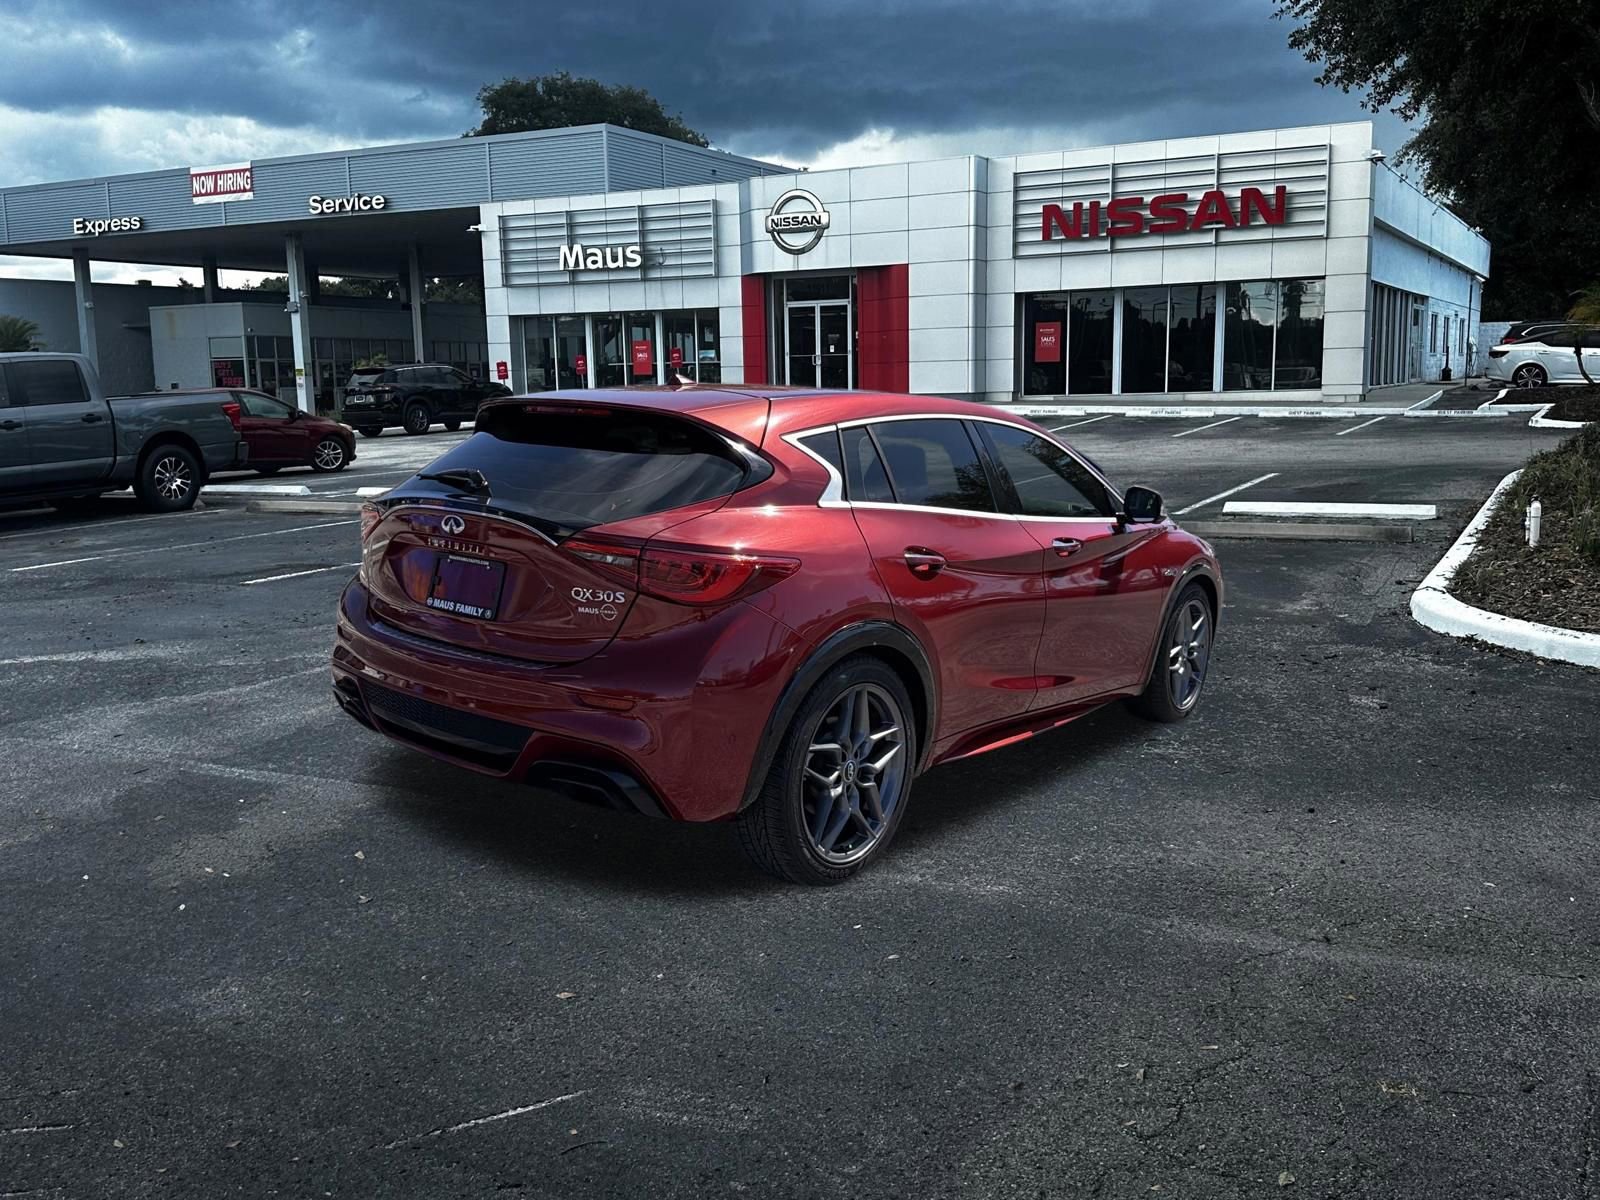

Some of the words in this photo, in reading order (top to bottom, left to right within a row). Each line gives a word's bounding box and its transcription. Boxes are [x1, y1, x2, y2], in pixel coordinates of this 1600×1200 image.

[192, 174, 215, 195] NOW
[217, 170, 251, 192] HIRING
[309, 193, 385, 214] Service
[1042, 185, 1287, 241] NISSAN
[73, 216, 141, 237] Express
[770, 215, 822, 228] NISSAN
[559, 243, 642, 271] Maus
[433, 598, 455, 611] MAUS
[455, 602, 484, 617] FAMILY
[578, 606, 599, 614] MAUS
